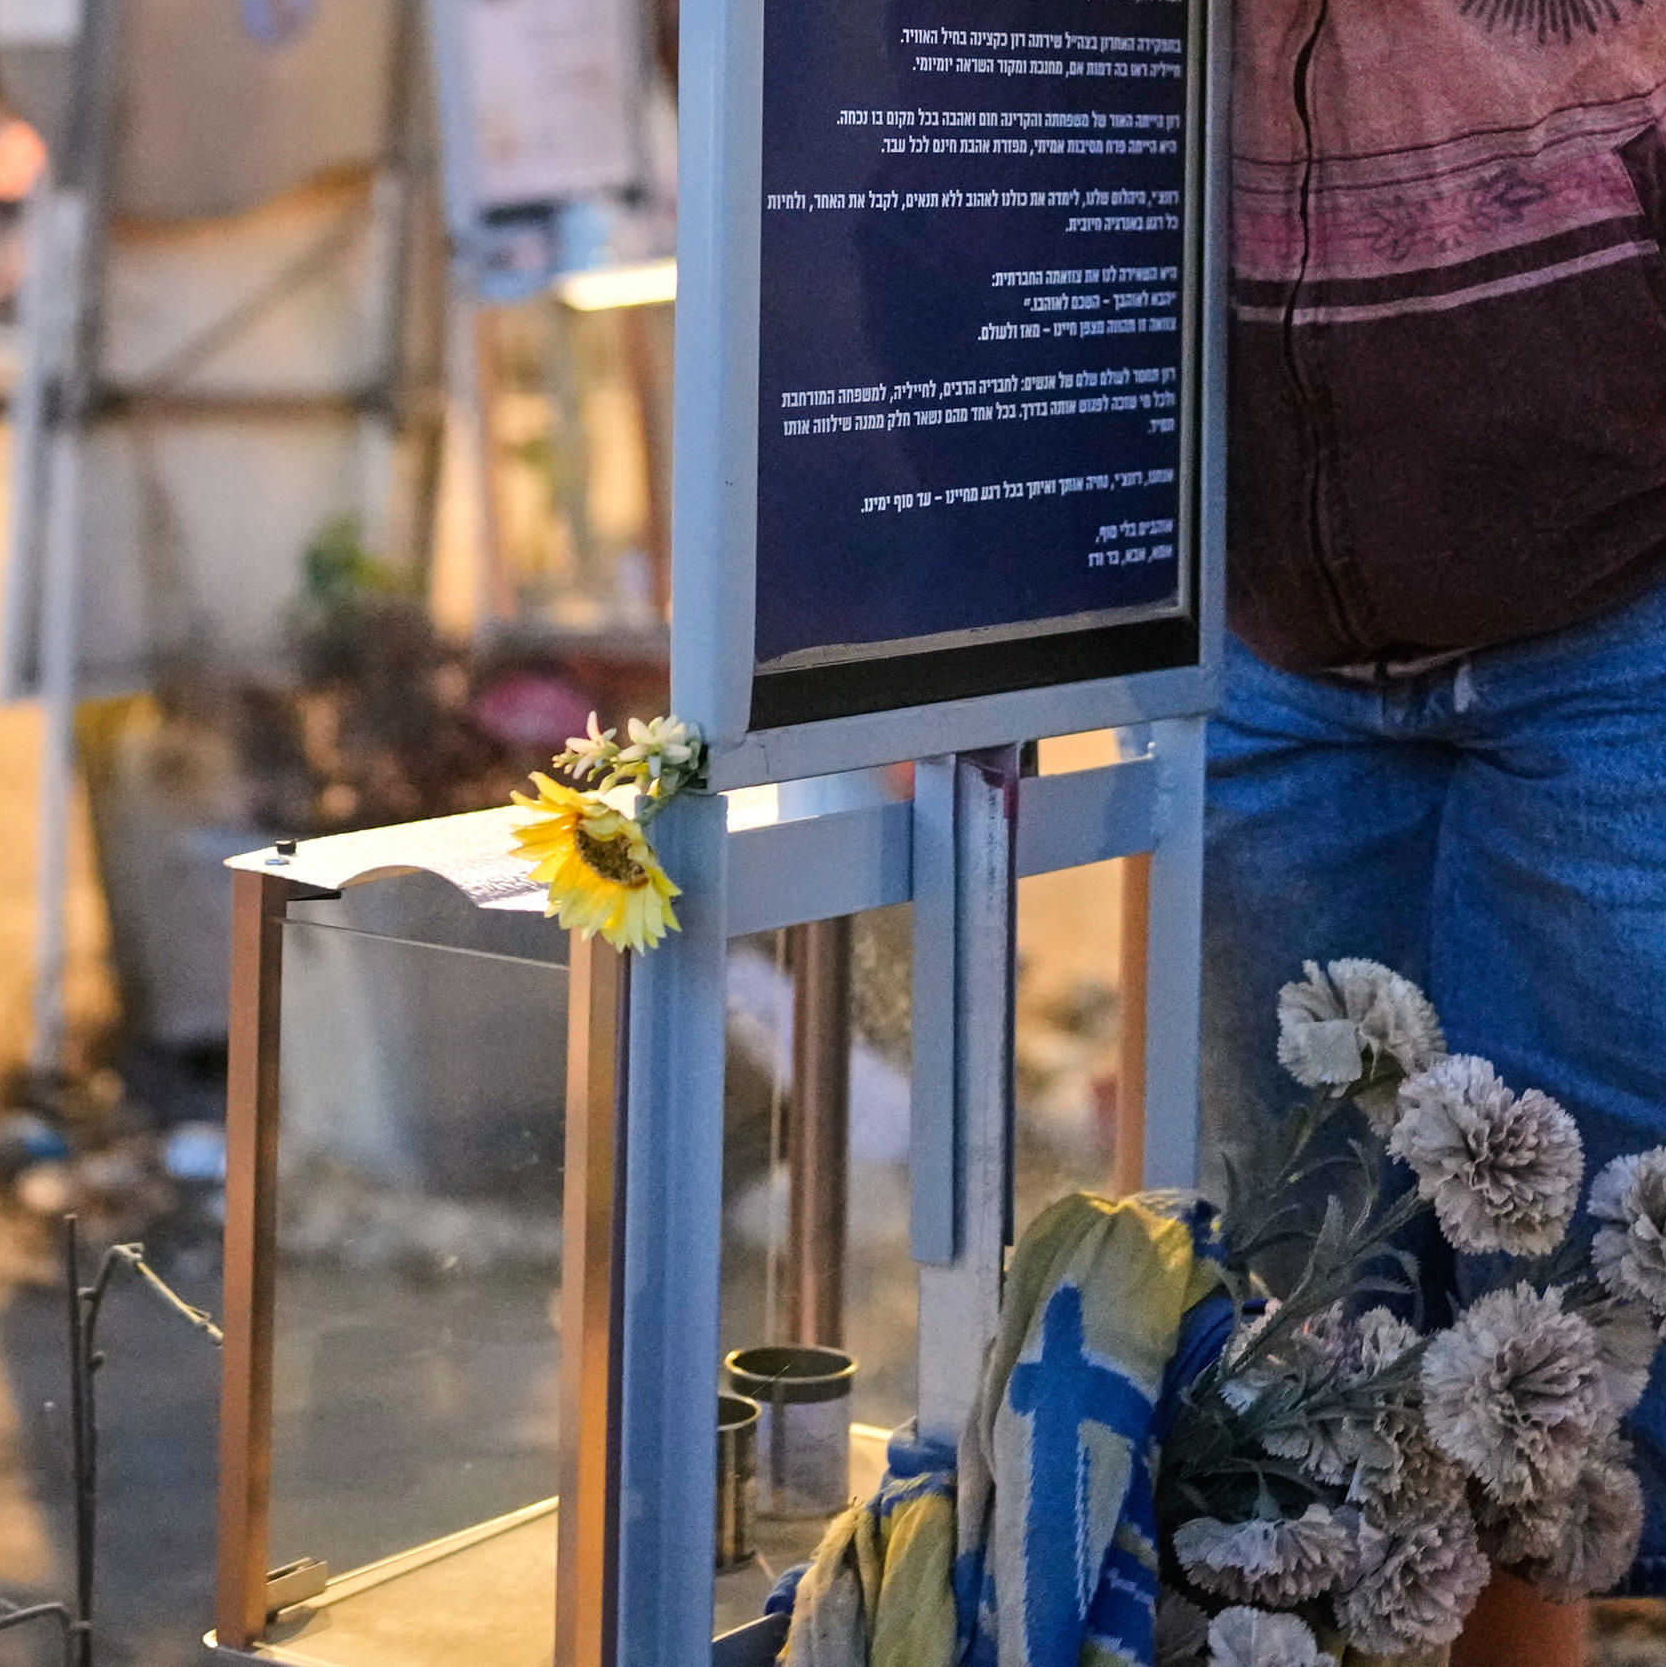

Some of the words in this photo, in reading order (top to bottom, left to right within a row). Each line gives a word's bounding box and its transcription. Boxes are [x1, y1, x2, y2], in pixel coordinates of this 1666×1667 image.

[900, 28, 938, 45] האוויר.
[940, 26, 967, 46] בחיל
[969, 31, 1008, 50] כקצינה
[1010, 32, 1026, 51] רון
[1027, 33, 1062, 50] שירתה
[912, 56, 953, 72] יומיומי.
[955, 57, 994, 73] השראה
[996, 58, 1027, 77] ומקור
[1029, 59, 1063, 75] מחנכת
[836, 109, 868, 125] נכחה.
[870, 110, 883, 126] בו
[886, 110, 915, 129] מקום
[917, 107, 939, 127] בכל
[941, 111, 976, 127] ואהבה
[978, 111, 998, 127] חום
[1000, 112, 1042, 130] והקרינה
[880, 138, 906, 153] עבר.
[908, 134, 930, 154] לכל
[932, 138, 957, 154] חינם
[959, 138, 990, 154] אהבת
[992, 138, 1027, 154] מפזרת
[1029, 139, 1065, 157] אמיתי,
[766, 190, 806, 210] ולחיות
[808, 193, 845, 213] האחר,
[848, 193, 865, 209] את
[868, 189, 898, 212] לקבל
[901, 192, 939, 211] תנאים,
[941, 189, 963, 208] ללא
[965, 188, 999, 208] לאהוב
[1000, 188, 1028, 207] כולנו
[1029, 191, 1046, 207] את
[991, 270, 1043, 287] החברתית:
[977, 321, 1018, 341] ולעולם.
[1019, 323, 1040, 339] מאז
[889, 379, 936, 404] לחייליה,
[938, 379, 976, 400] הרבים,
[978, 374, 1018, 395] לחבריה
[1020, 375, 1056, 392] אנשים:
[781, 389, 835, 408] המורחבת
[837, 382, 887, 404] למשפחה
[913, 409, 942, 426] נשאר
[944, 407, 968, 424] מהם
[970, 405, 993, 422] אחד
[995, 401, 1016, 420] בכל
[1018, 401, 1048, 421] בדרך.
[783, 419, 810, 437] אותו
[812, 413, 852, 434] שילווה
[854, 413, 885, 431] ממנה
[887, 409, 910, 432] חלק
[945, 486, 978, 505] מחיינו
[980, 484, 1001, 501] רגע
[1002, 480, 1024, 499] בכל
[1025, 479, 1056, 500] ואיתך
[860, 495, 890, 513] ימינו.
[893, 493, 913, 513] סוף
[915, 491, 931, 508] עד
